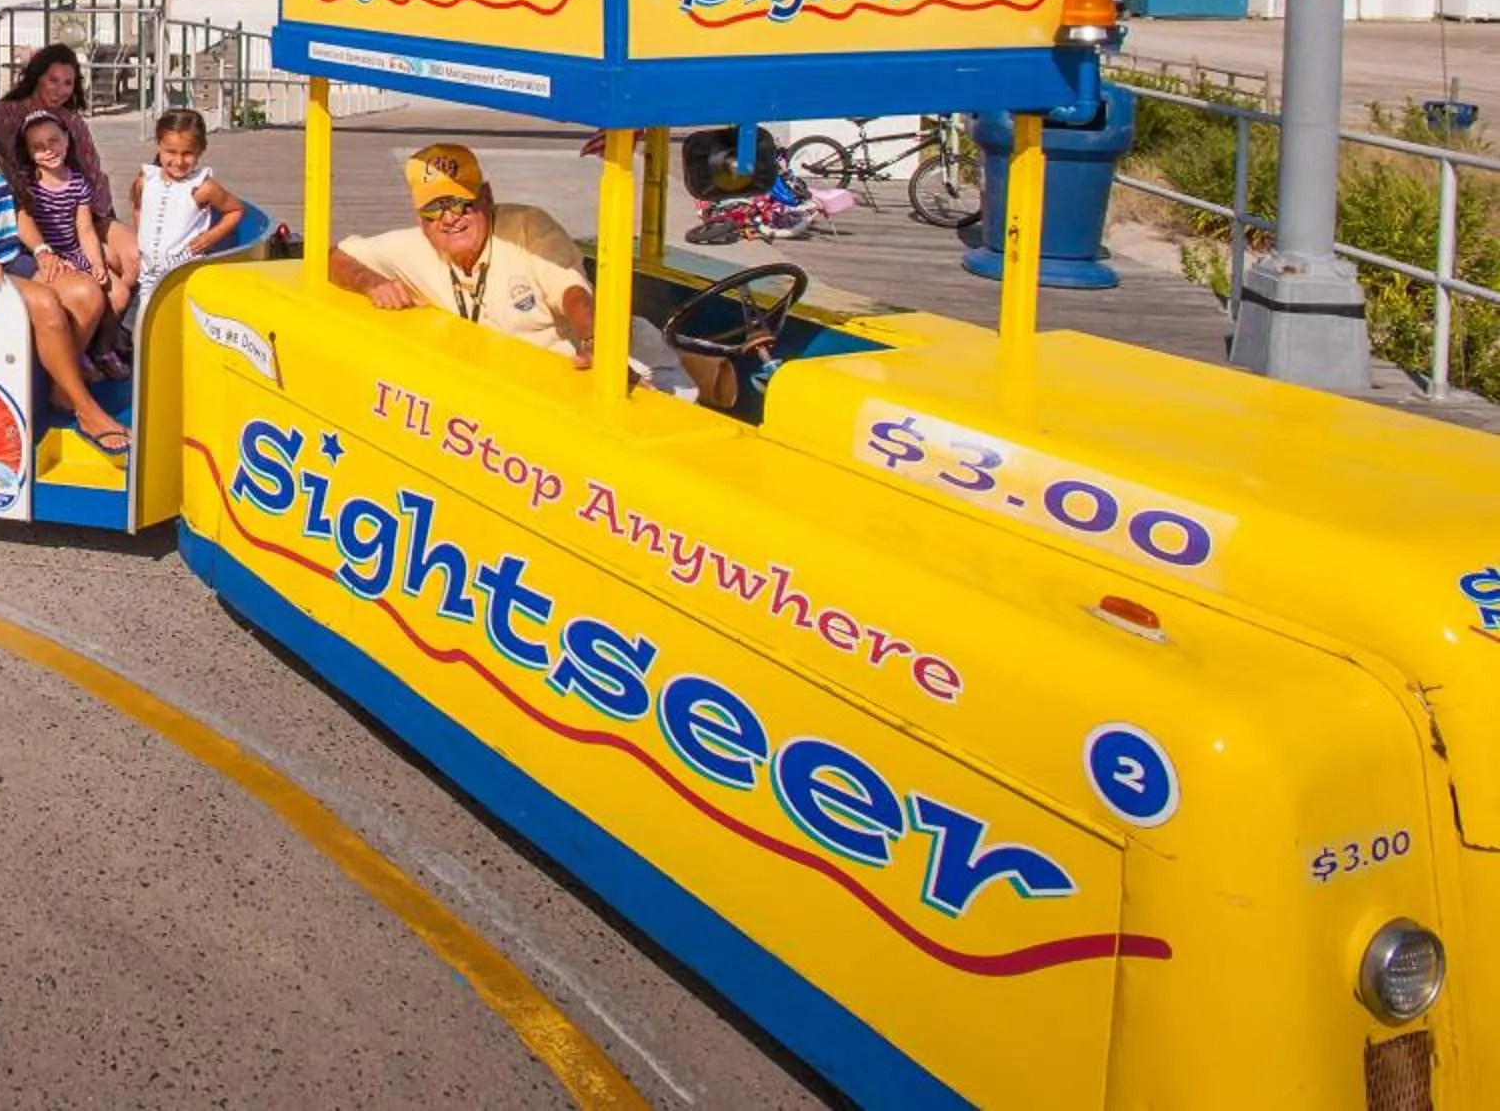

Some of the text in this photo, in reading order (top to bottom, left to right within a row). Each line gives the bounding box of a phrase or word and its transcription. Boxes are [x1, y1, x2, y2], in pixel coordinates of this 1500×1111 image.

[372, 381, 965, 703] I'll Stop Anywhere
[867, 416, 1212, 566] $3.00
[230, 419, 1079, 919] Sightseer
[1112, 754, 1146, 794] 2
[1311, 828, 1413, 883] $3.00
